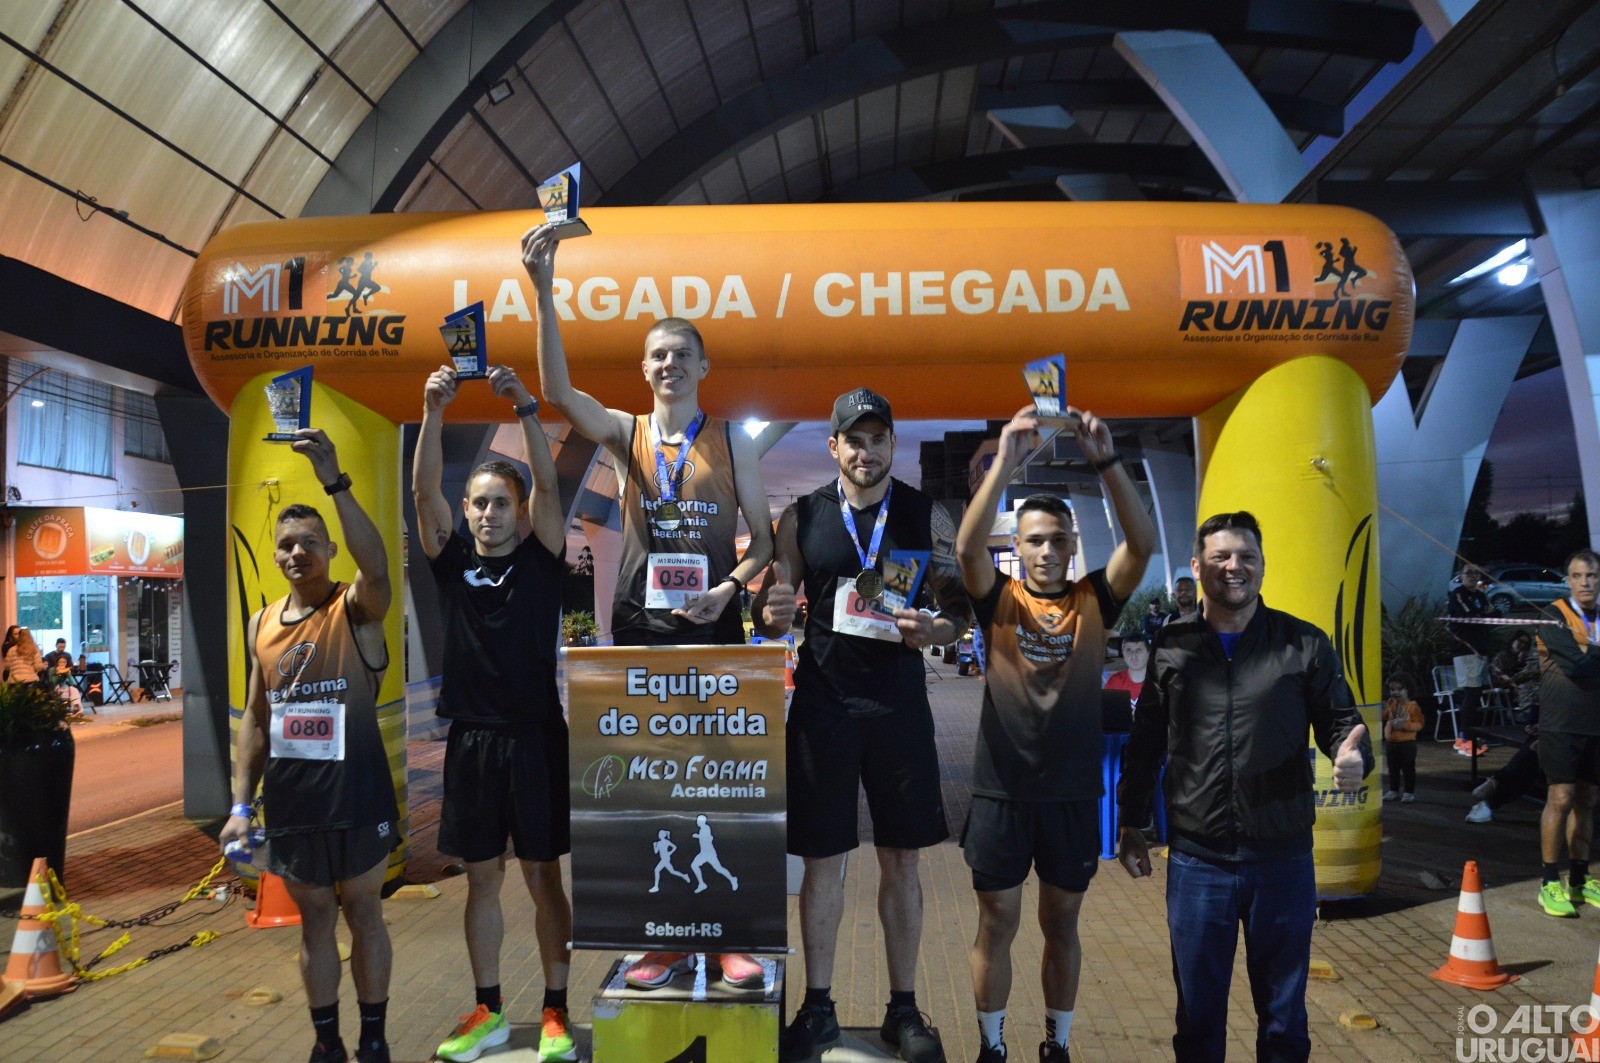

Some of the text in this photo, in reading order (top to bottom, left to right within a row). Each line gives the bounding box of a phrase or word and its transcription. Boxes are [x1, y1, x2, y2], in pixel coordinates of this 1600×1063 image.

[1202, 239, 1290, 294] M1
[223, 256, 306, 314] M1
[453, 274, 757, 322] LARGADA
[813, 267, 1131, 317] CHEGADA
[1178, 298, 1393, 331] RUNNING
[204, 315, 406, 352] RUNNING
[1183, 333, 1233, 343] Assessoria
[1243, 332, 1300, 343] Organização
[1302, 332, 1314, 342] de
[1316, 332, 1349, 342] Corrida
[1351, 332, 1362, 342] de
[1363, 333, 1380, 342] Rua
[211, 350, 255, 361] Assessoria
[263, 348, 319, 361] Organização
[320, 348, 332, 357] de
[333, 348, 368, 357] Corrida
[370, 348, 380, 357] de
[381, 347, 399, 356] Rua
[677, 498, 719, 515] orma
[659, 569, 699, 587] 056
[290, 677, 348, 698] Forma
[626, 667, 739, 702] Equipe
[290, 719, 329, 737] 080
[598, 707, 768, 737] de corrida
[670, 783, 766, 798] Academia
[645, 921, 723, 937] Seberi-RS
